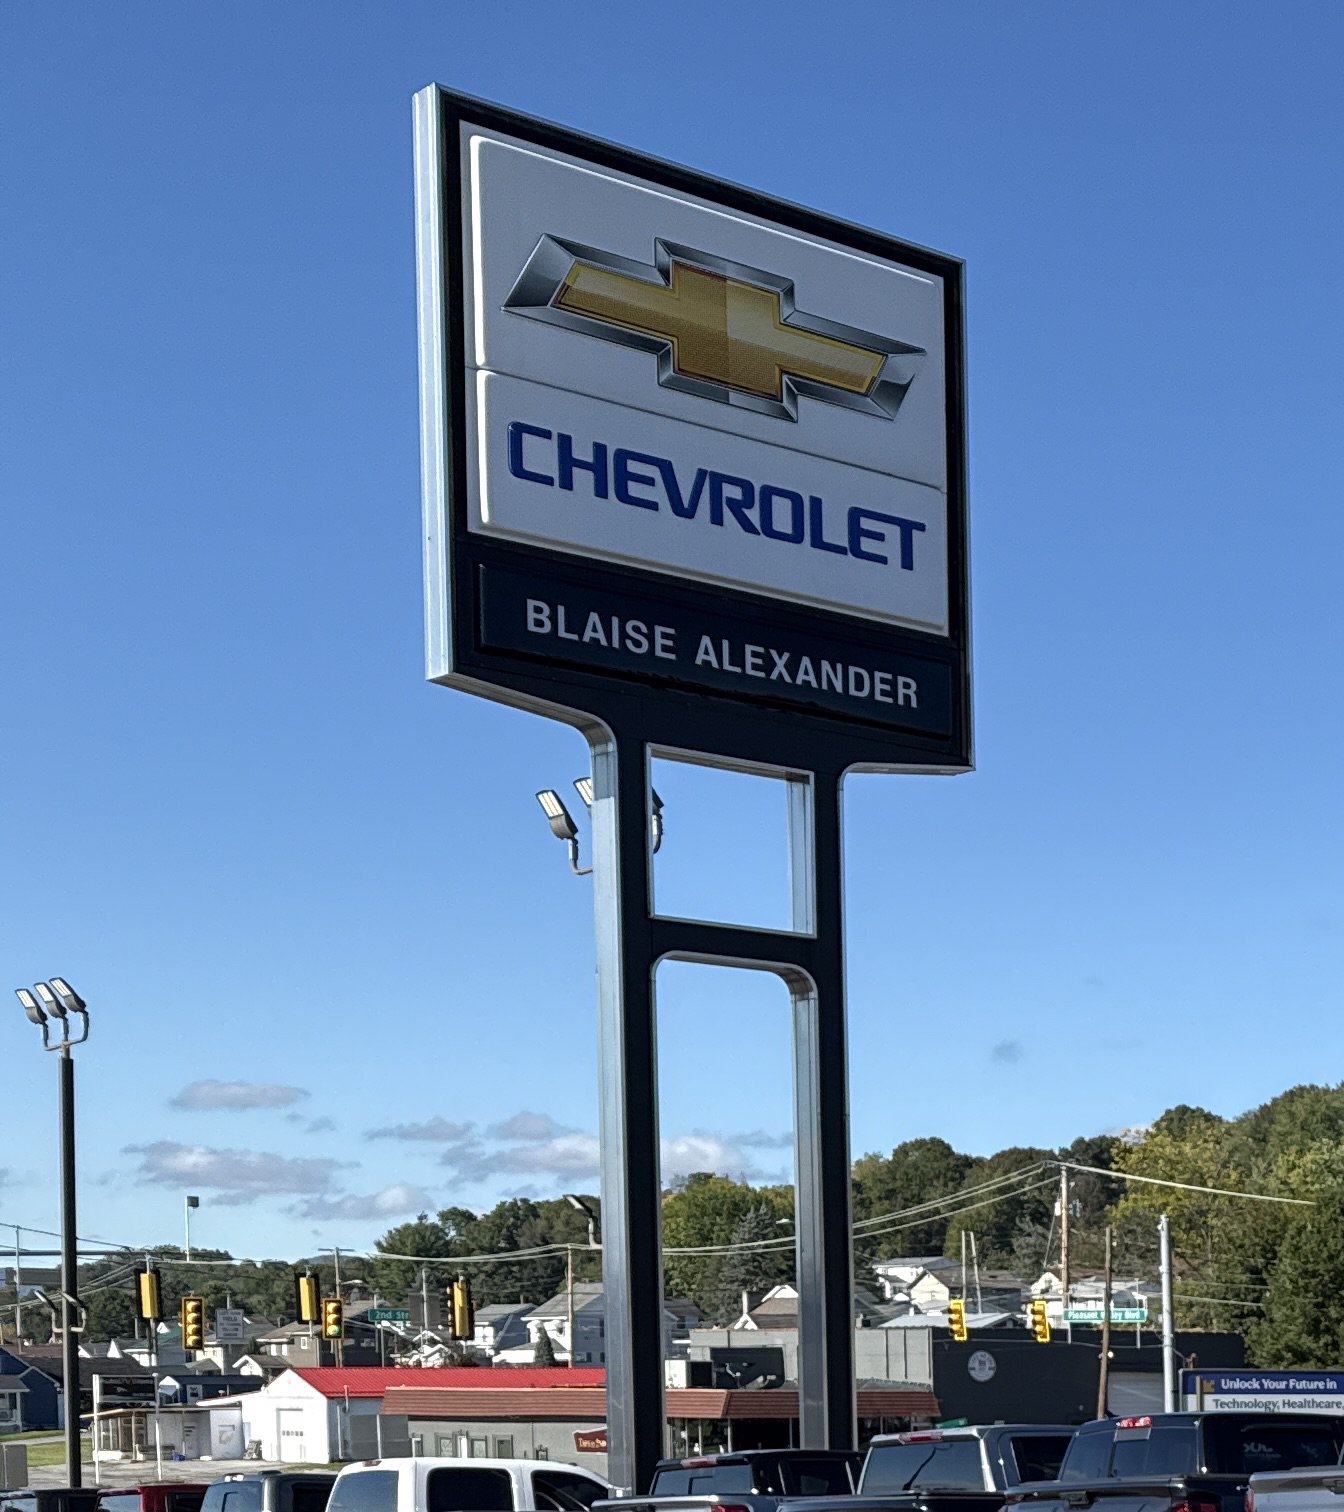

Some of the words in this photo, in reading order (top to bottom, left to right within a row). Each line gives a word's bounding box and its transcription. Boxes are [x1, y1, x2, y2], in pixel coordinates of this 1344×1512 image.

[508, 421, 926, 571] CHEVROLET
[526, 598, 676, 660] BLAISE
[694, 634, 918, 708] ALEXANDER
[375, 1310, 393, 1319] 2nd
[1221, 1378, 1261, 1390] Unlock
[1261, 1378, 1288, 1390] Your
[1289, 1378, 1325, 1390] Future
[1325, 1378, 1338, 1390] in
